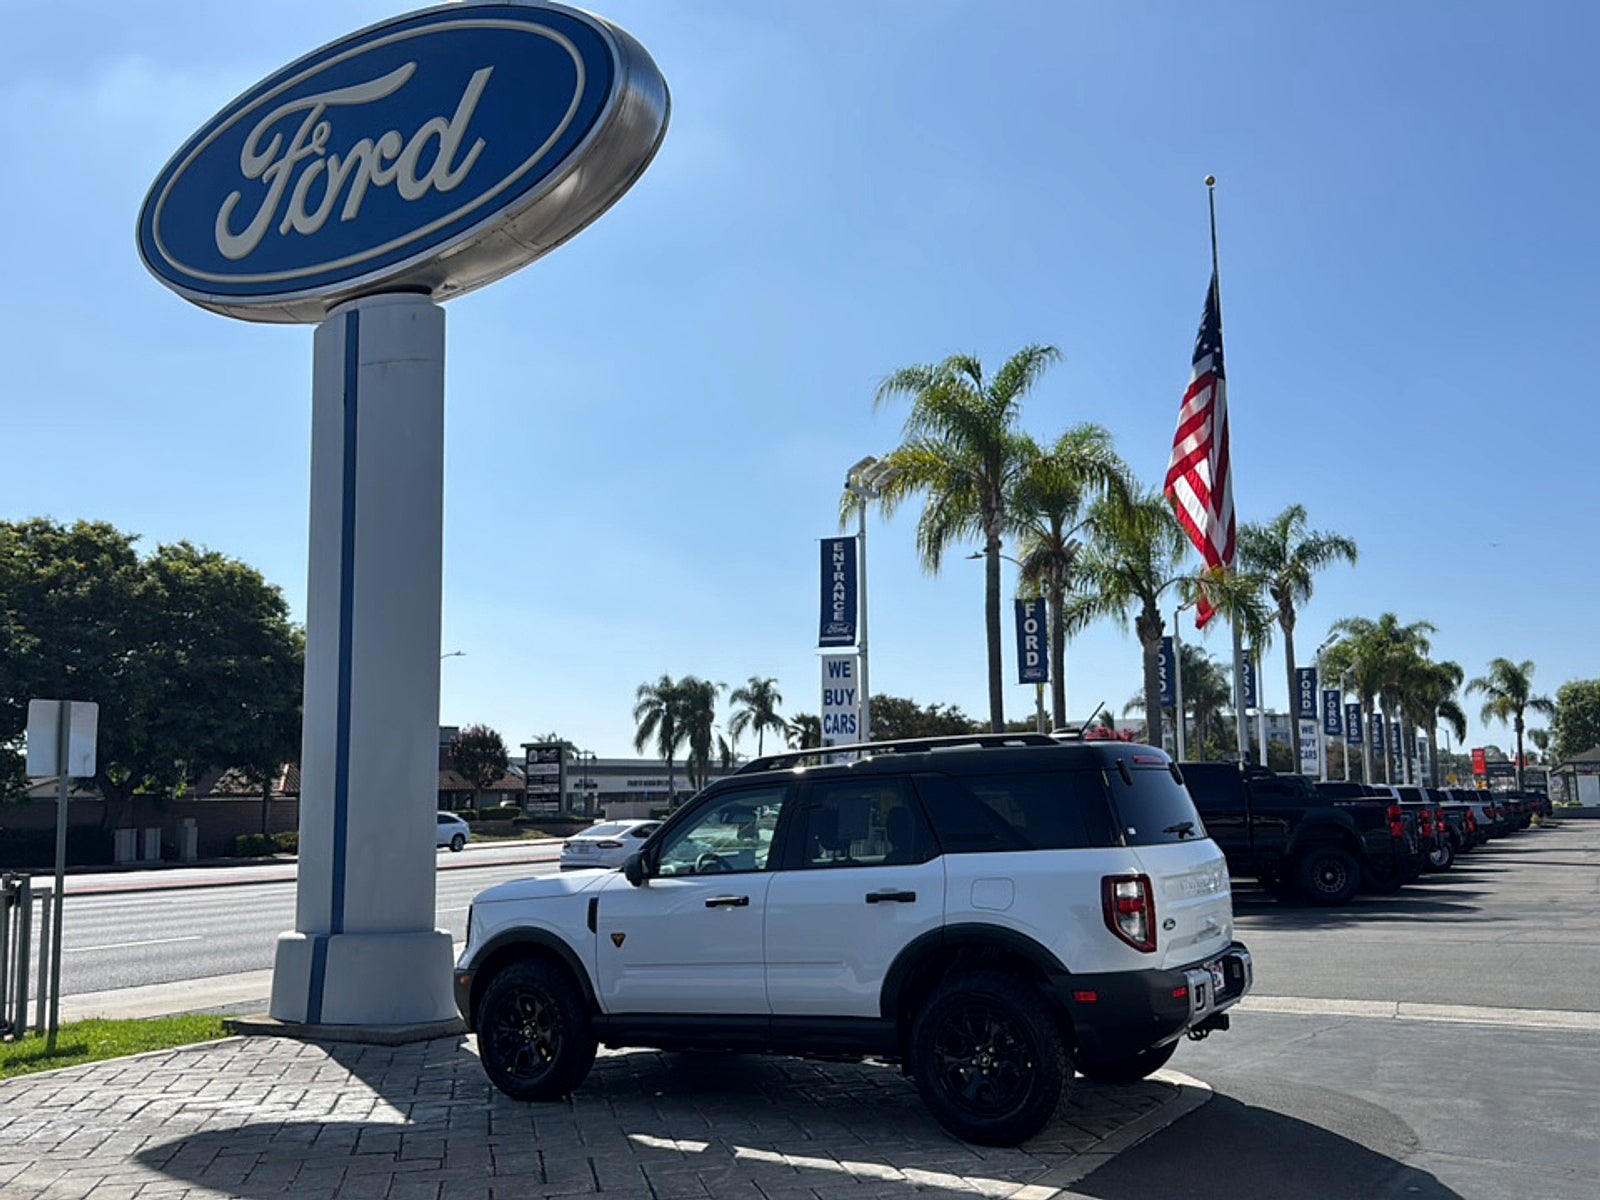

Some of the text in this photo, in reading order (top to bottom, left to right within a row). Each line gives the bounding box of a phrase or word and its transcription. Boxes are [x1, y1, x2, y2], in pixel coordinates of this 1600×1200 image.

[214, 62, 494, 260] Ford
[833, 542, 845, 621] ENTRANCE
[1024, 603, 1039, 666] FORD
[828, 661, 851, 678] WE
[824, 688, 855, 706] BUY
[1301, 670, 1312, 709] FORD
[824, 714, 856, 734] CARS
[1327, 692, 1337, 726] FORD
[1348, 706, 1358, 736] FORD
[1300, 739, 1316, 748] BUY
[1301, 725, 1314, 734] WE
